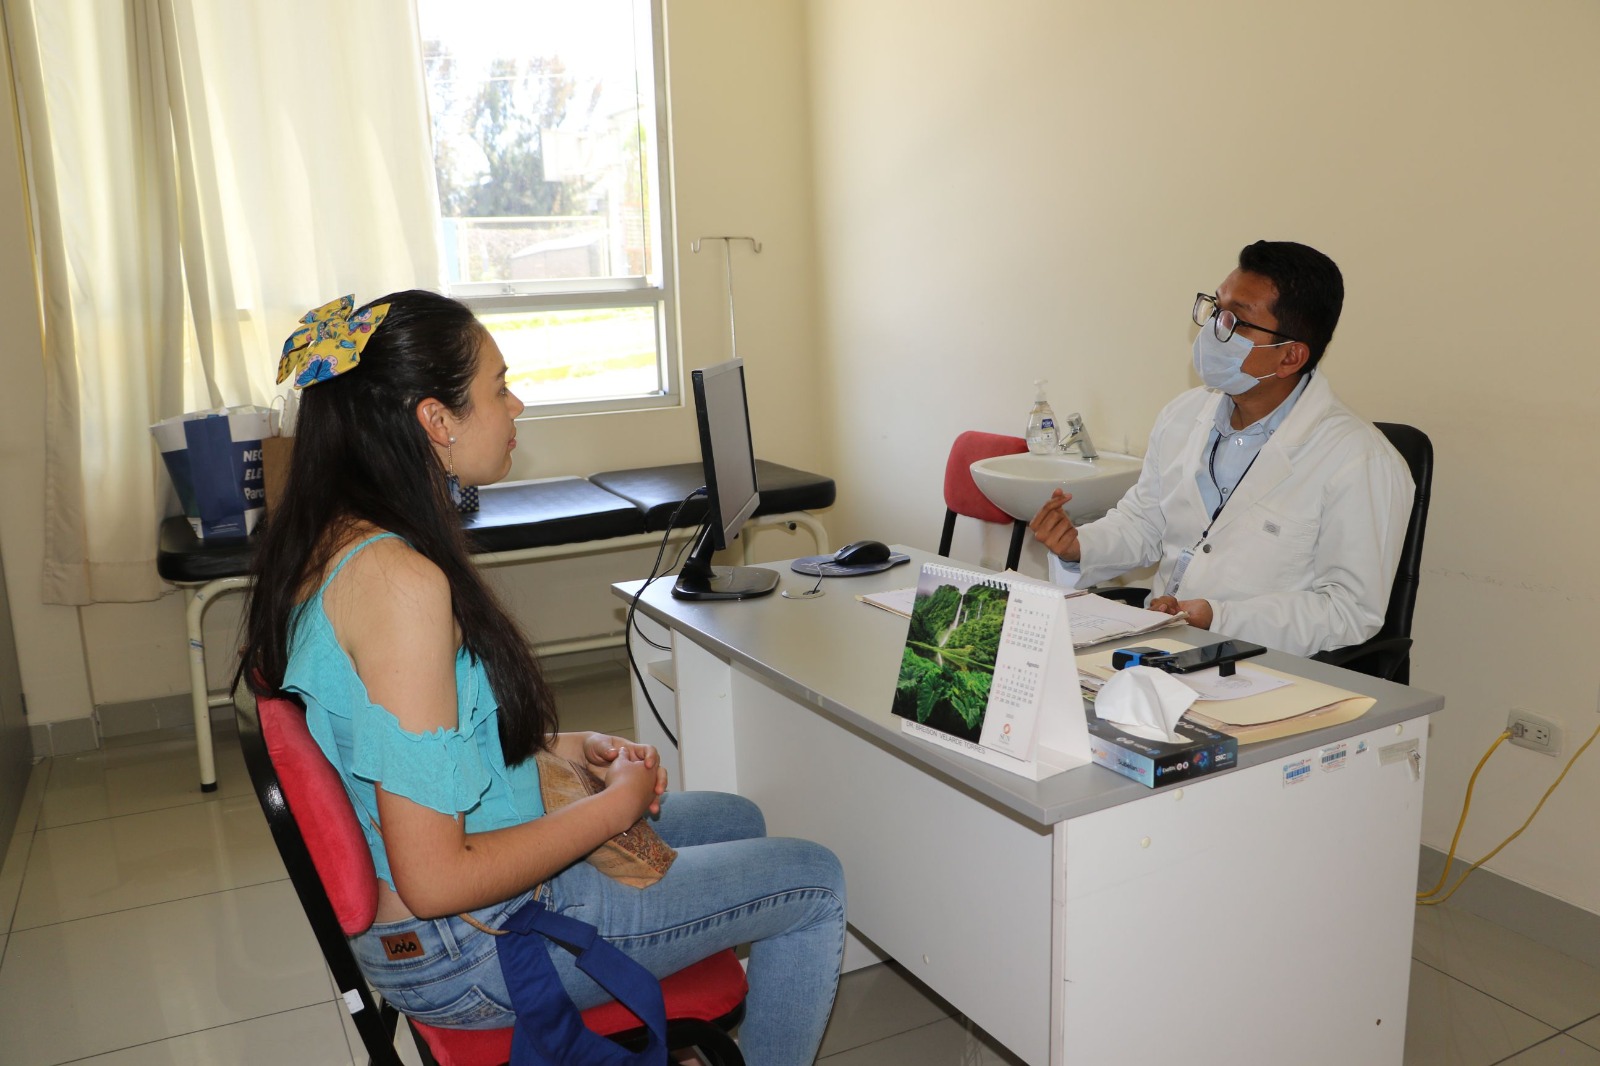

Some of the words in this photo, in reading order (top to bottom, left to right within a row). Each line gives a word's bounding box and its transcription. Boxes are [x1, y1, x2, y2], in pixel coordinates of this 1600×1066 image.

[940, 732, 962, 746] VELARDE
[964, 740, 986, 754] TORRES
[386, 939, 418, 954] Lois
